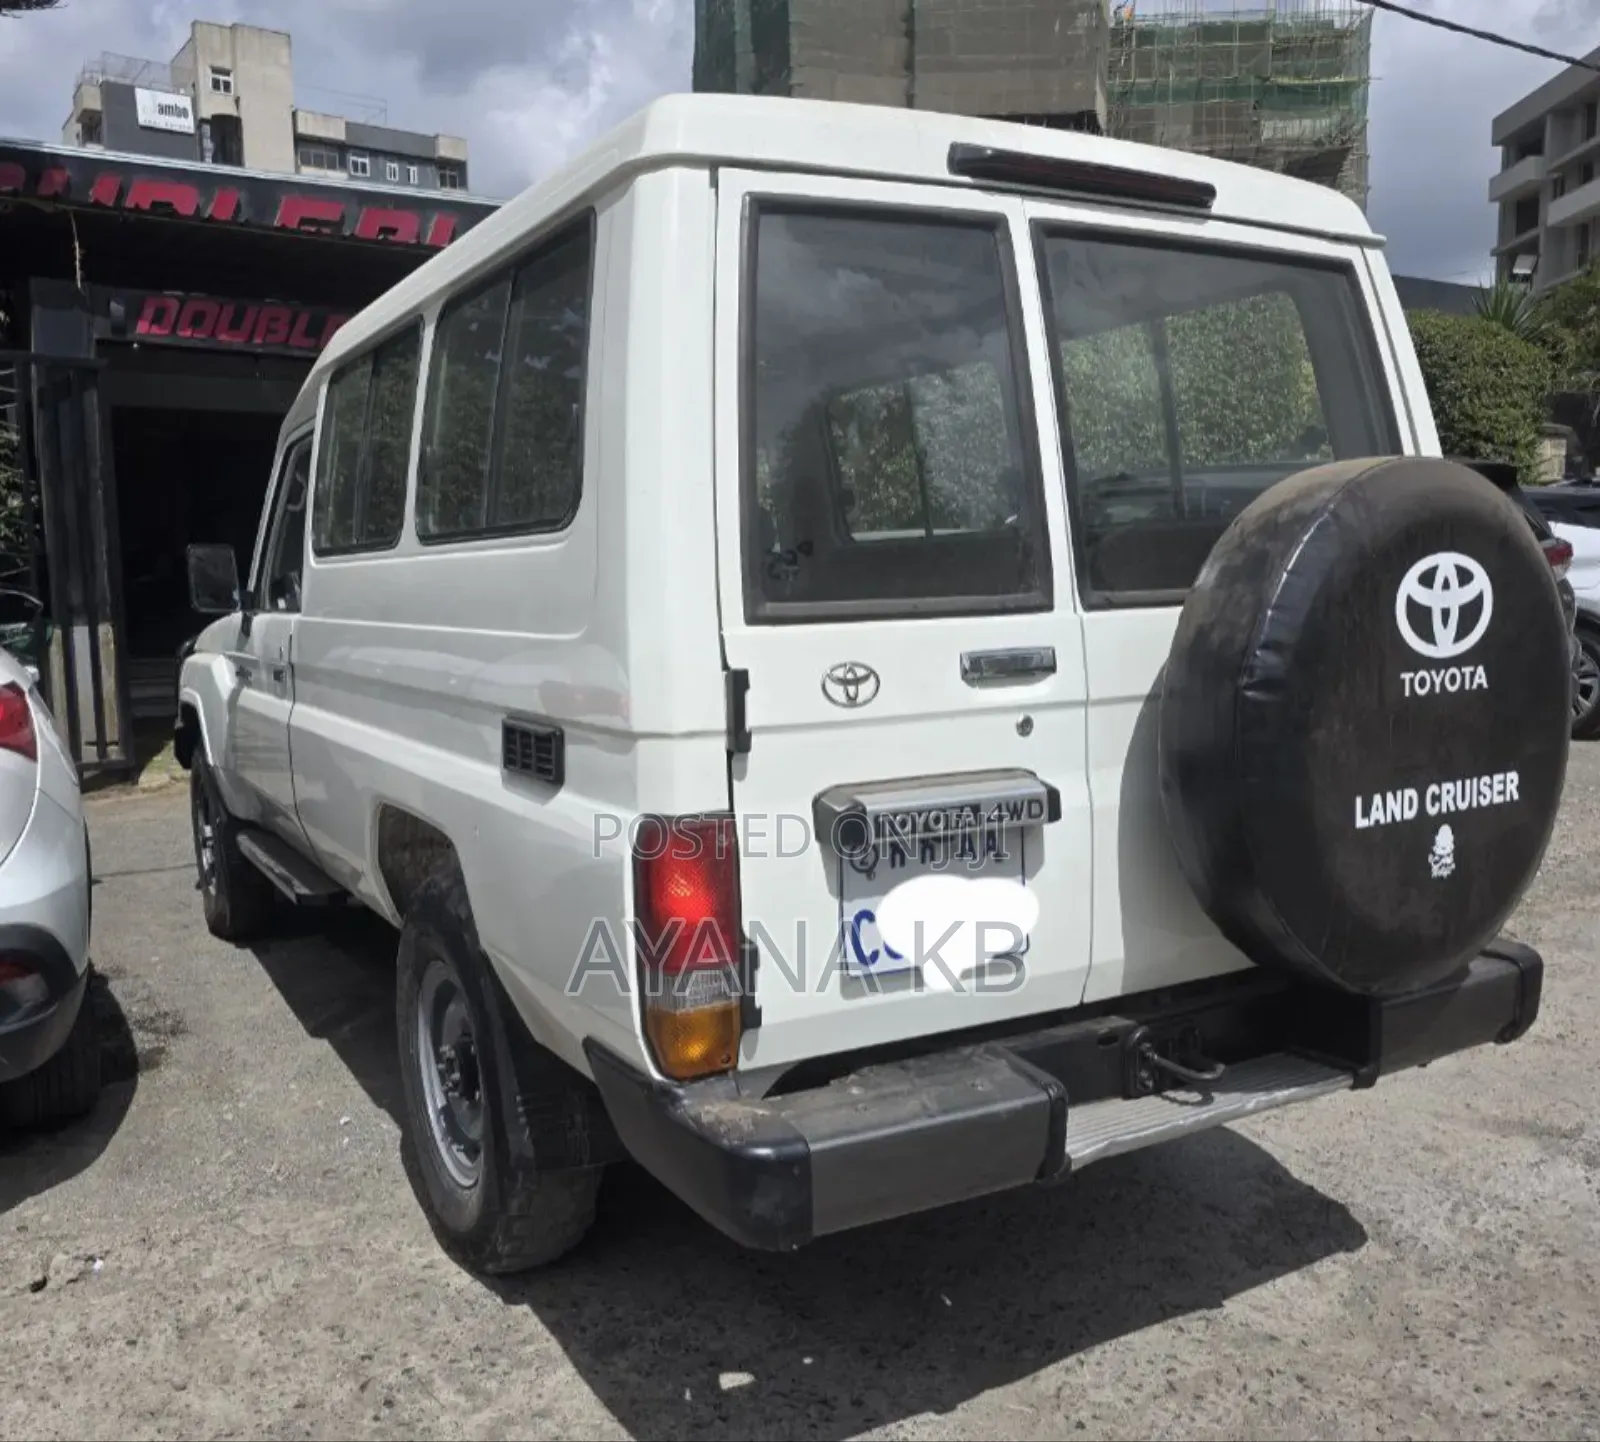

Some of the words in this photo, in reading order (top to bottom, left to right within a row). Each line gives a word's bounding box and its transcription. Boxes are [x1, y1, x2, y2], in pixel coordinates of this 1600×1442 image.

[1400, 664, 1489, 697] TOYOTA
[876, 804, 978, 835] TOYOTA
[986, 798, 1045, 823] 4WD
[1355, 788, 1419, 829] LAND
[1425, 770, 1520, 817] CRUISER
